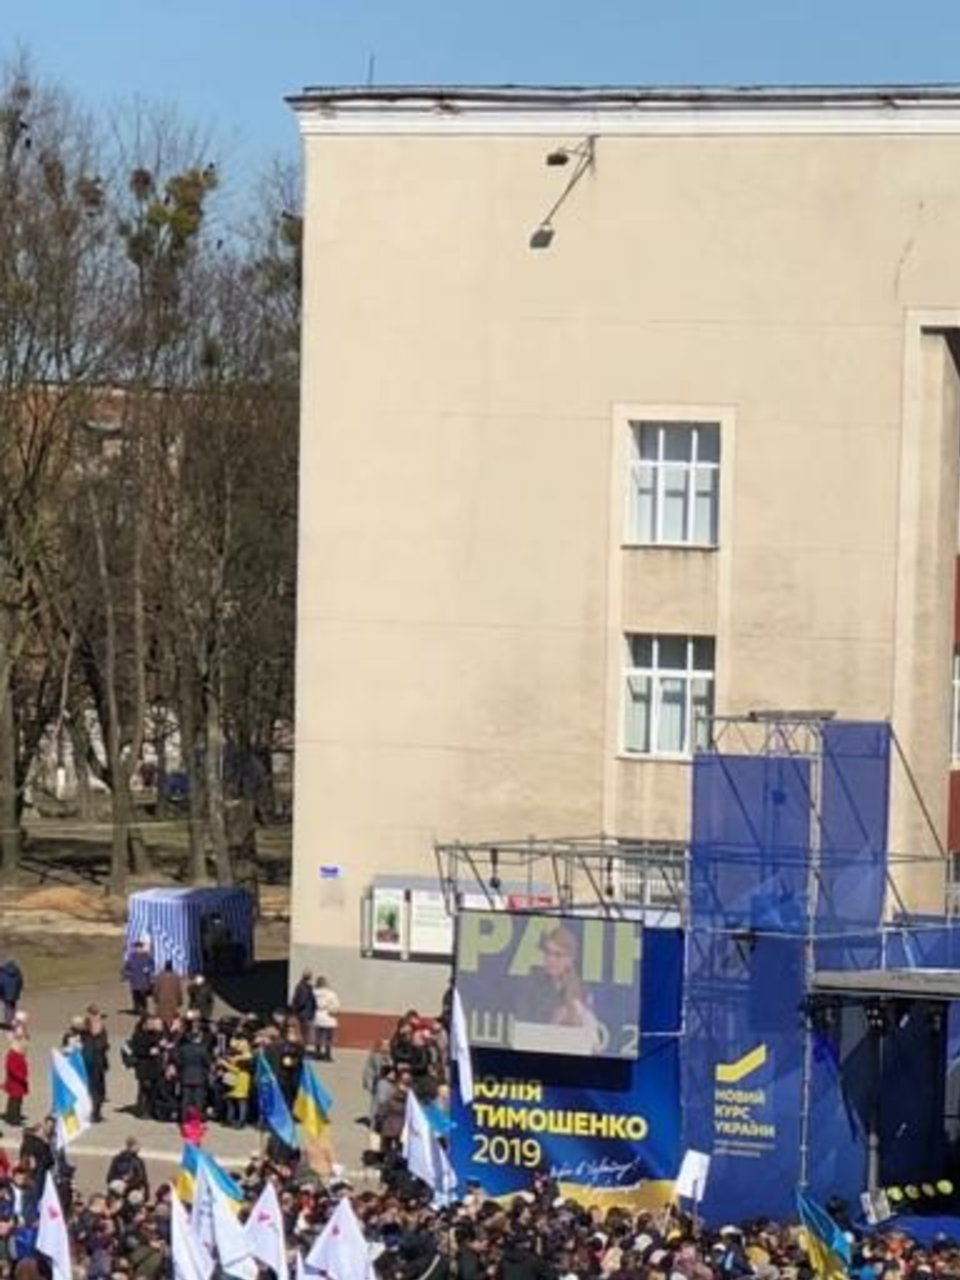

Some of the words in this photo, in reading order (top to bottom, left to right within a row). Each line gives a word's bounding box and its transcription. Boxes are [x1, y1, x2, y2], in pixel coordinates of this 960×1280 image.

[474, 1075, 541, 1103] ЮЛІЯ
[472, 1104, 648, 1141] ТИМОШЕНКО
[715, 1106, 751, 1120] КУРС
[472, 1134, 541, 1168] 2019
